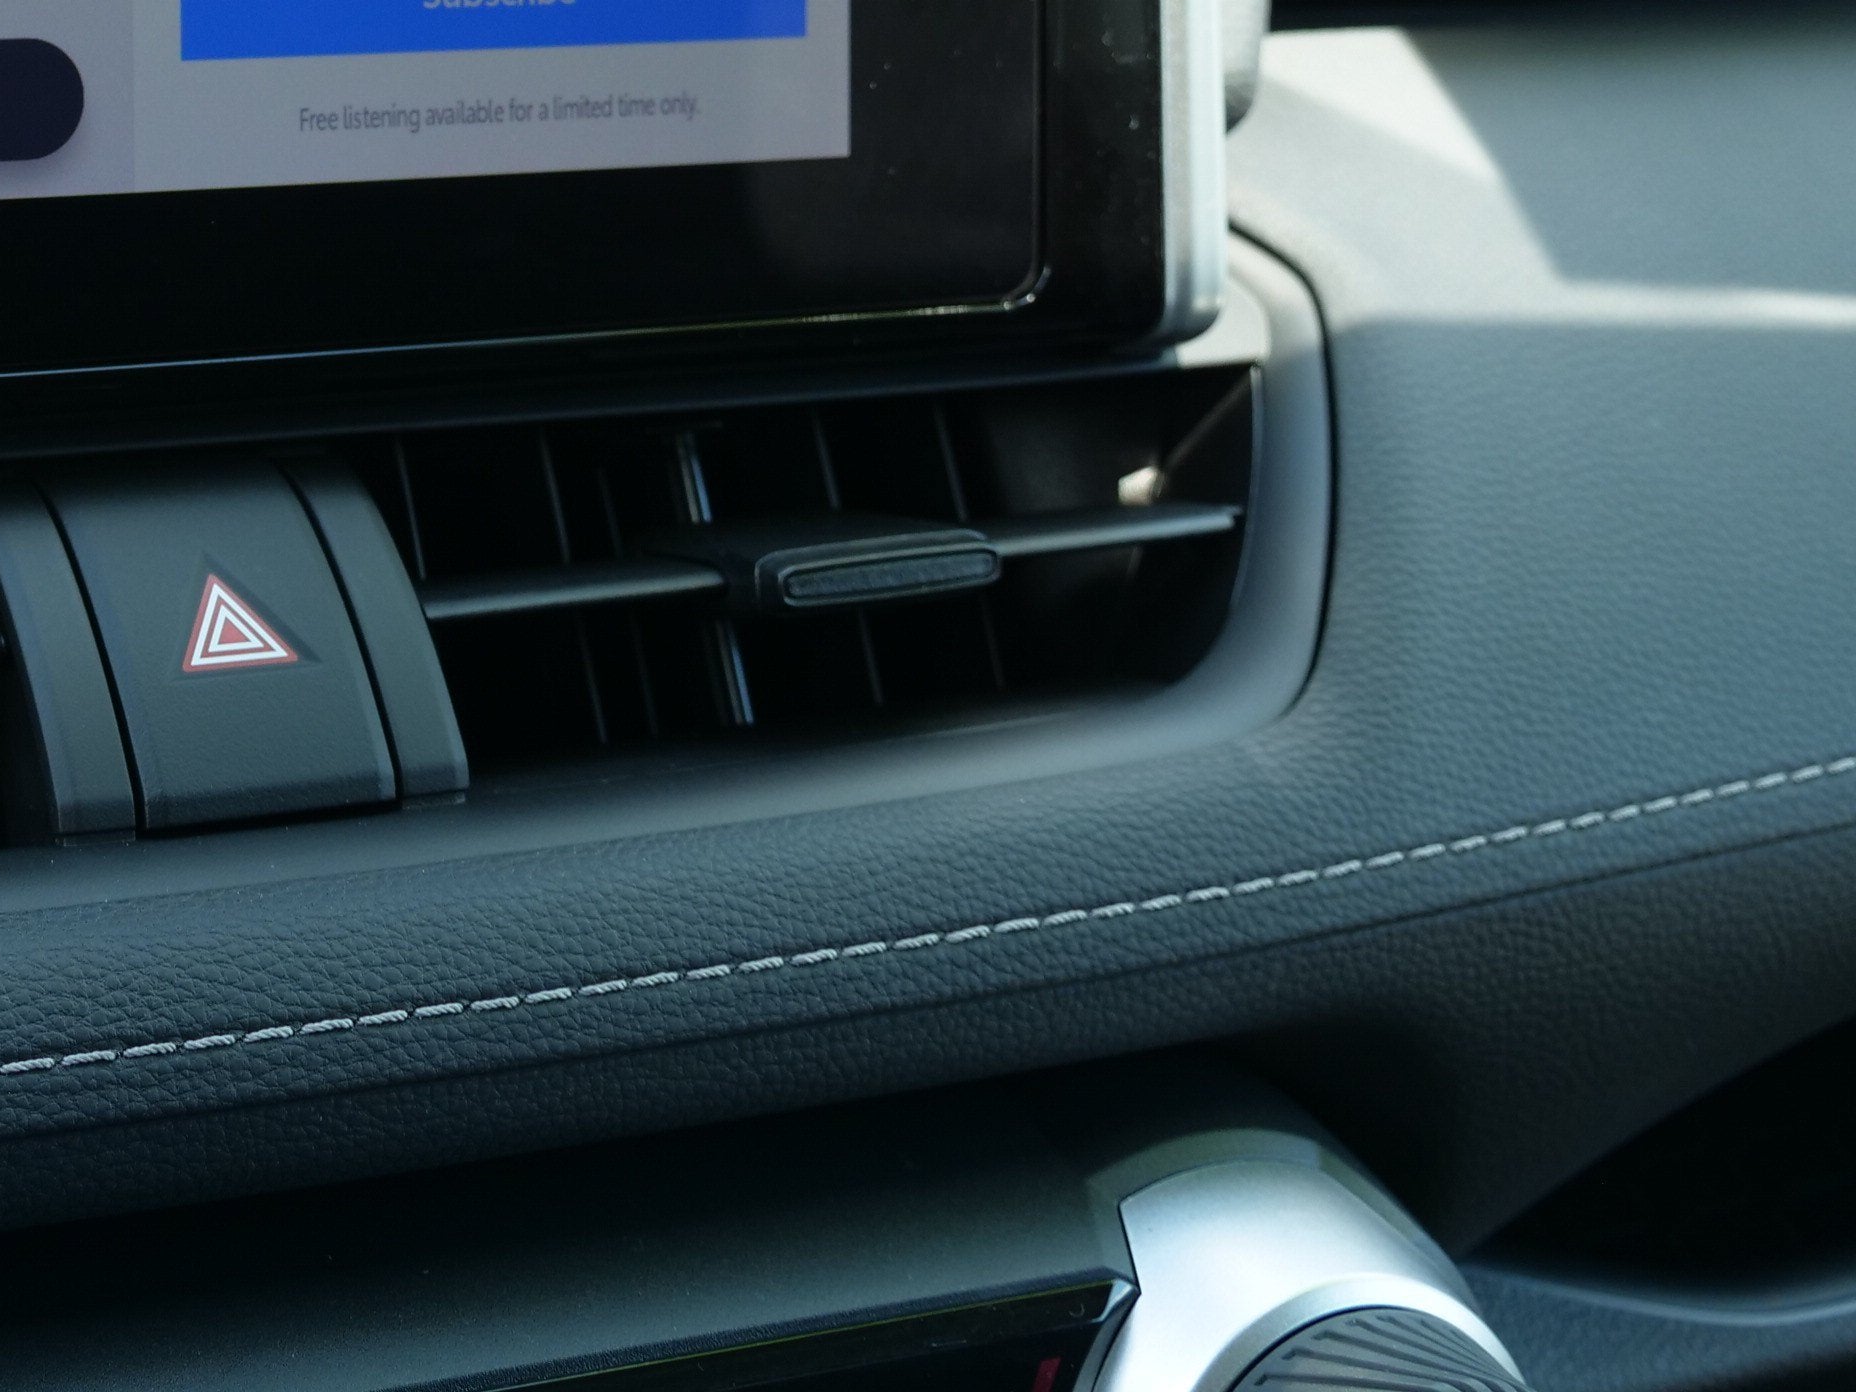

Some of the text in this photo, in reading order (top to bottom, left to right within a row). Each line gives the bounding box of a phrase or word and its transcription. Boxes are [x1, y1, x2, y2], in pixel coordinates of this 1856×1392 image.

[299, 107, 339, 132] Free
[343, 105, 420, 134] listening
[425, 99, 505, 126] available
[509, 97, 533, 122] for
[553, 93, 613, 120] limited
[618, 92, 656, 117] time
